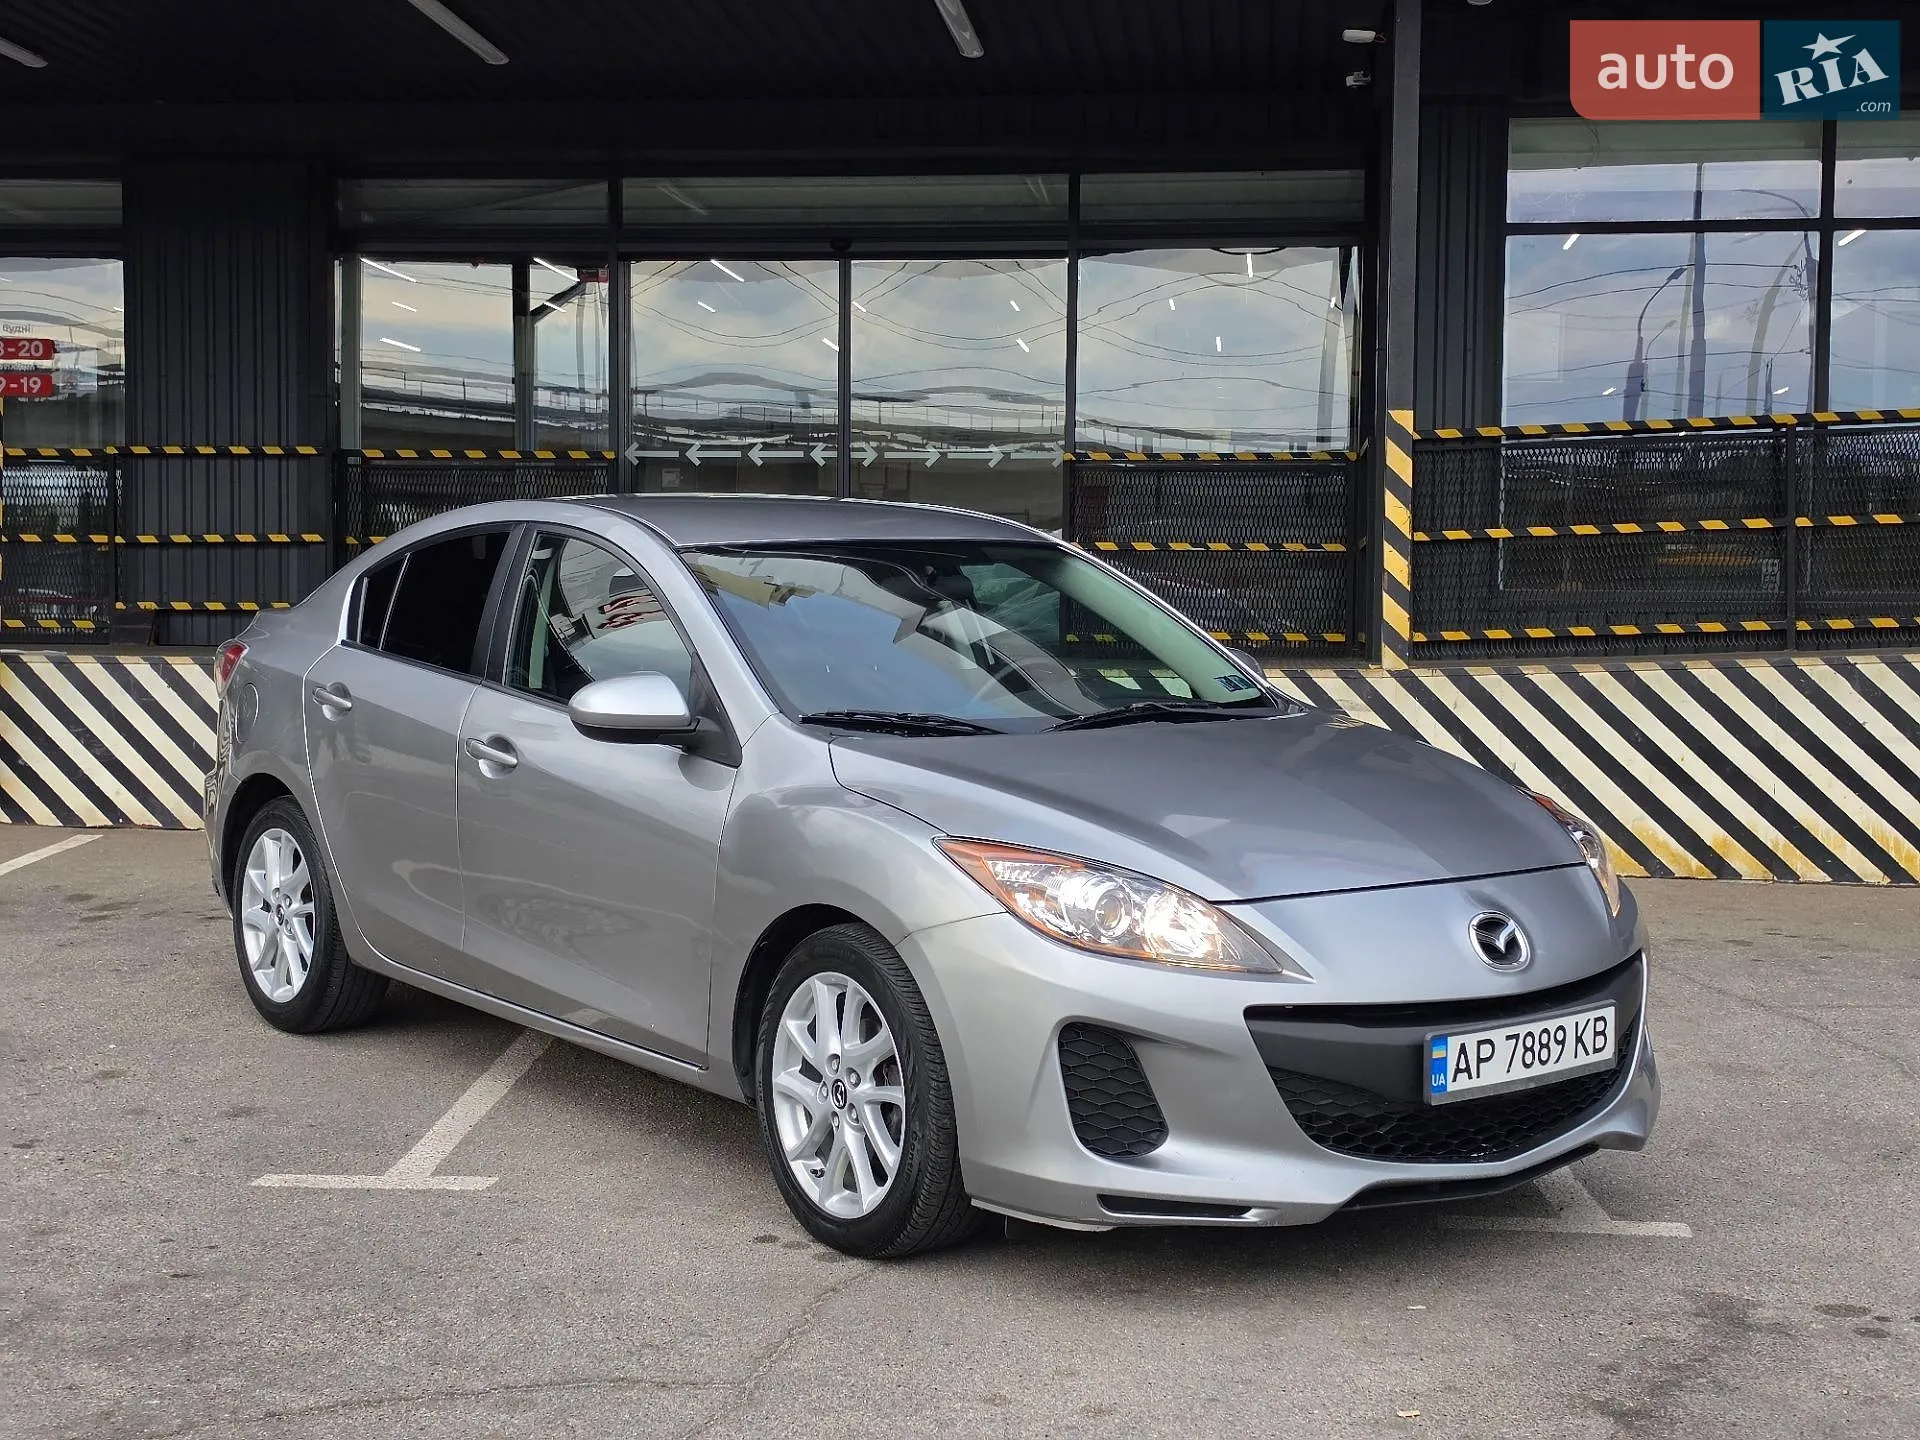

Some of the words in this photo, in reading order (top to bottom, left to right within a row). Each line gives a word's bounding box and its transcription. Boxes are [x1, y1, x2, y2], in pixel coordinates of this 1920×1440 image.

[1451, 1038, 1496, 1083] AP
[1505, 1024, 1567, 1073] 7889
[1574, 1015, 1608, 1059] KB
[1431, 1073, 1446, 1087] UA
